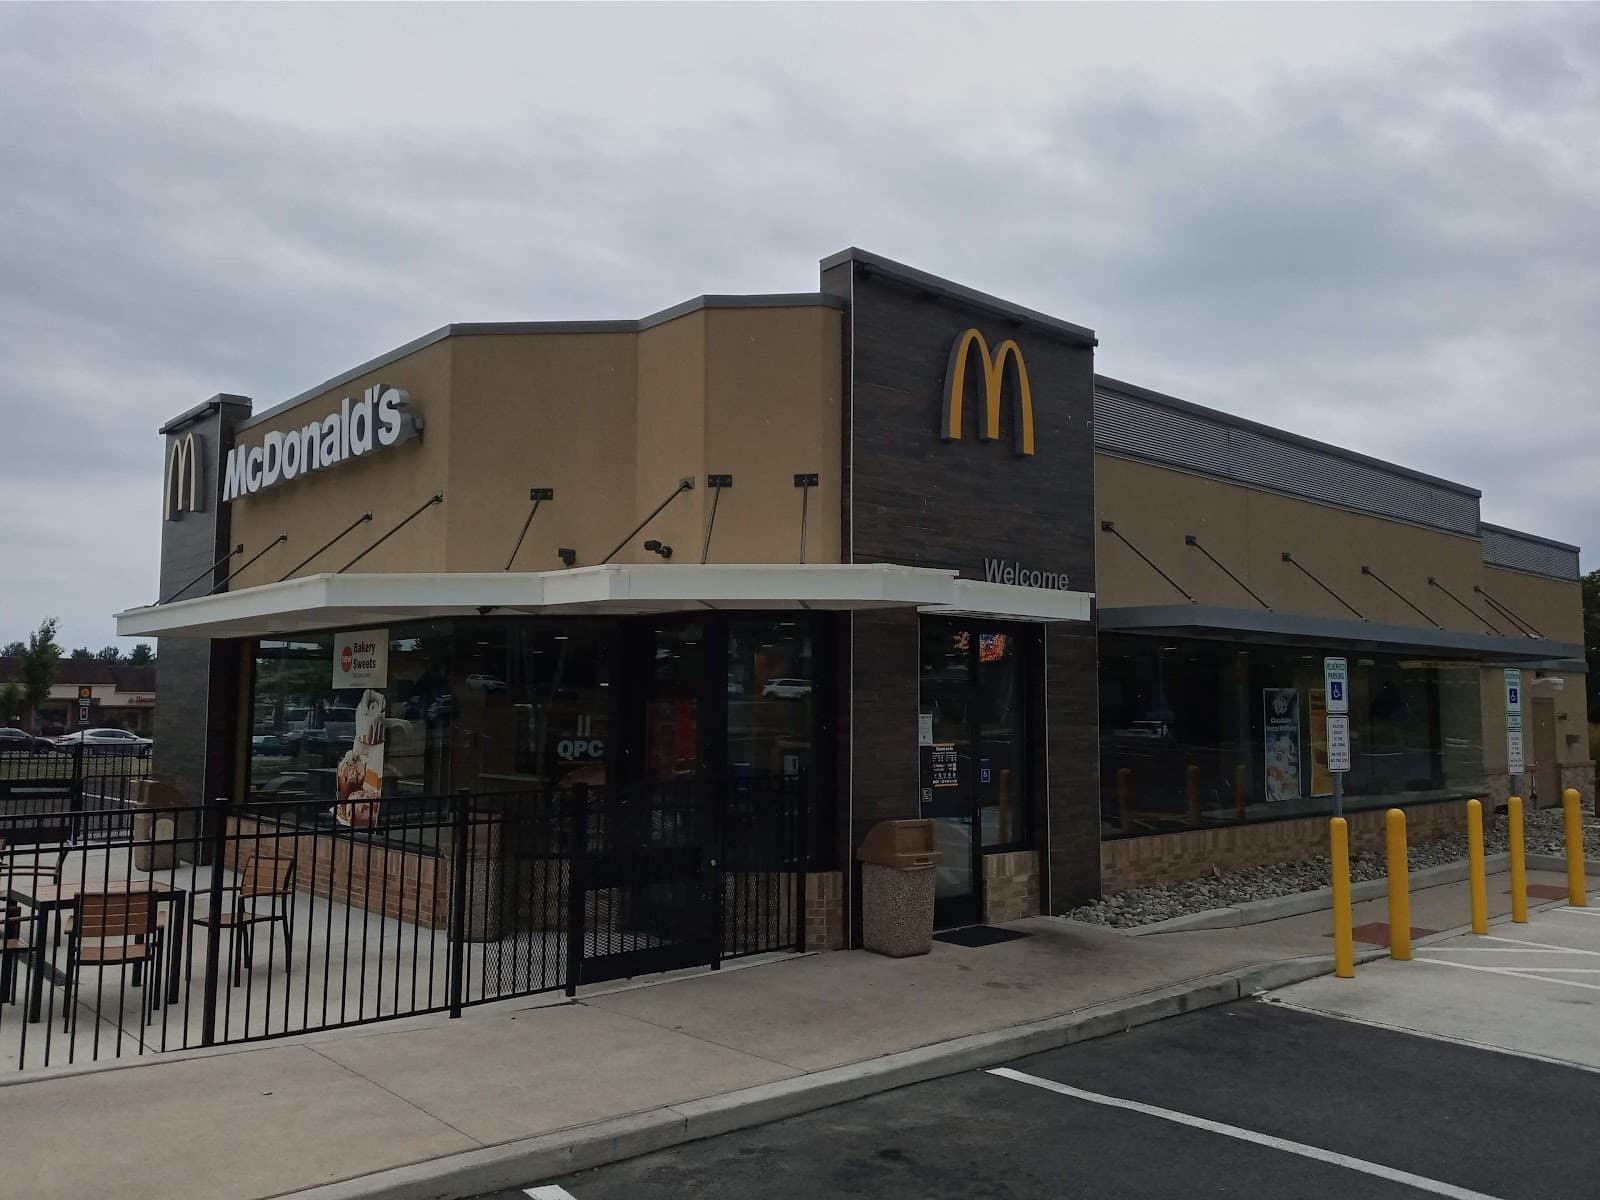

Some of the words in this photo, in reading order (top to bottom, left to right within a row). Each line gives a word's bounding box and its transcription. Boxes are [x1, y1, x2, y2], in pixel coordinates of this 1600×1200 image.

[223, 384, 402, 503] McDonald's
[984, 557, 1070, 590] Welcome
[353, 641, 376, 656] Bakery
[353, 658, 376, 670] Sweets
[557, 739, 604, 761] QPC
